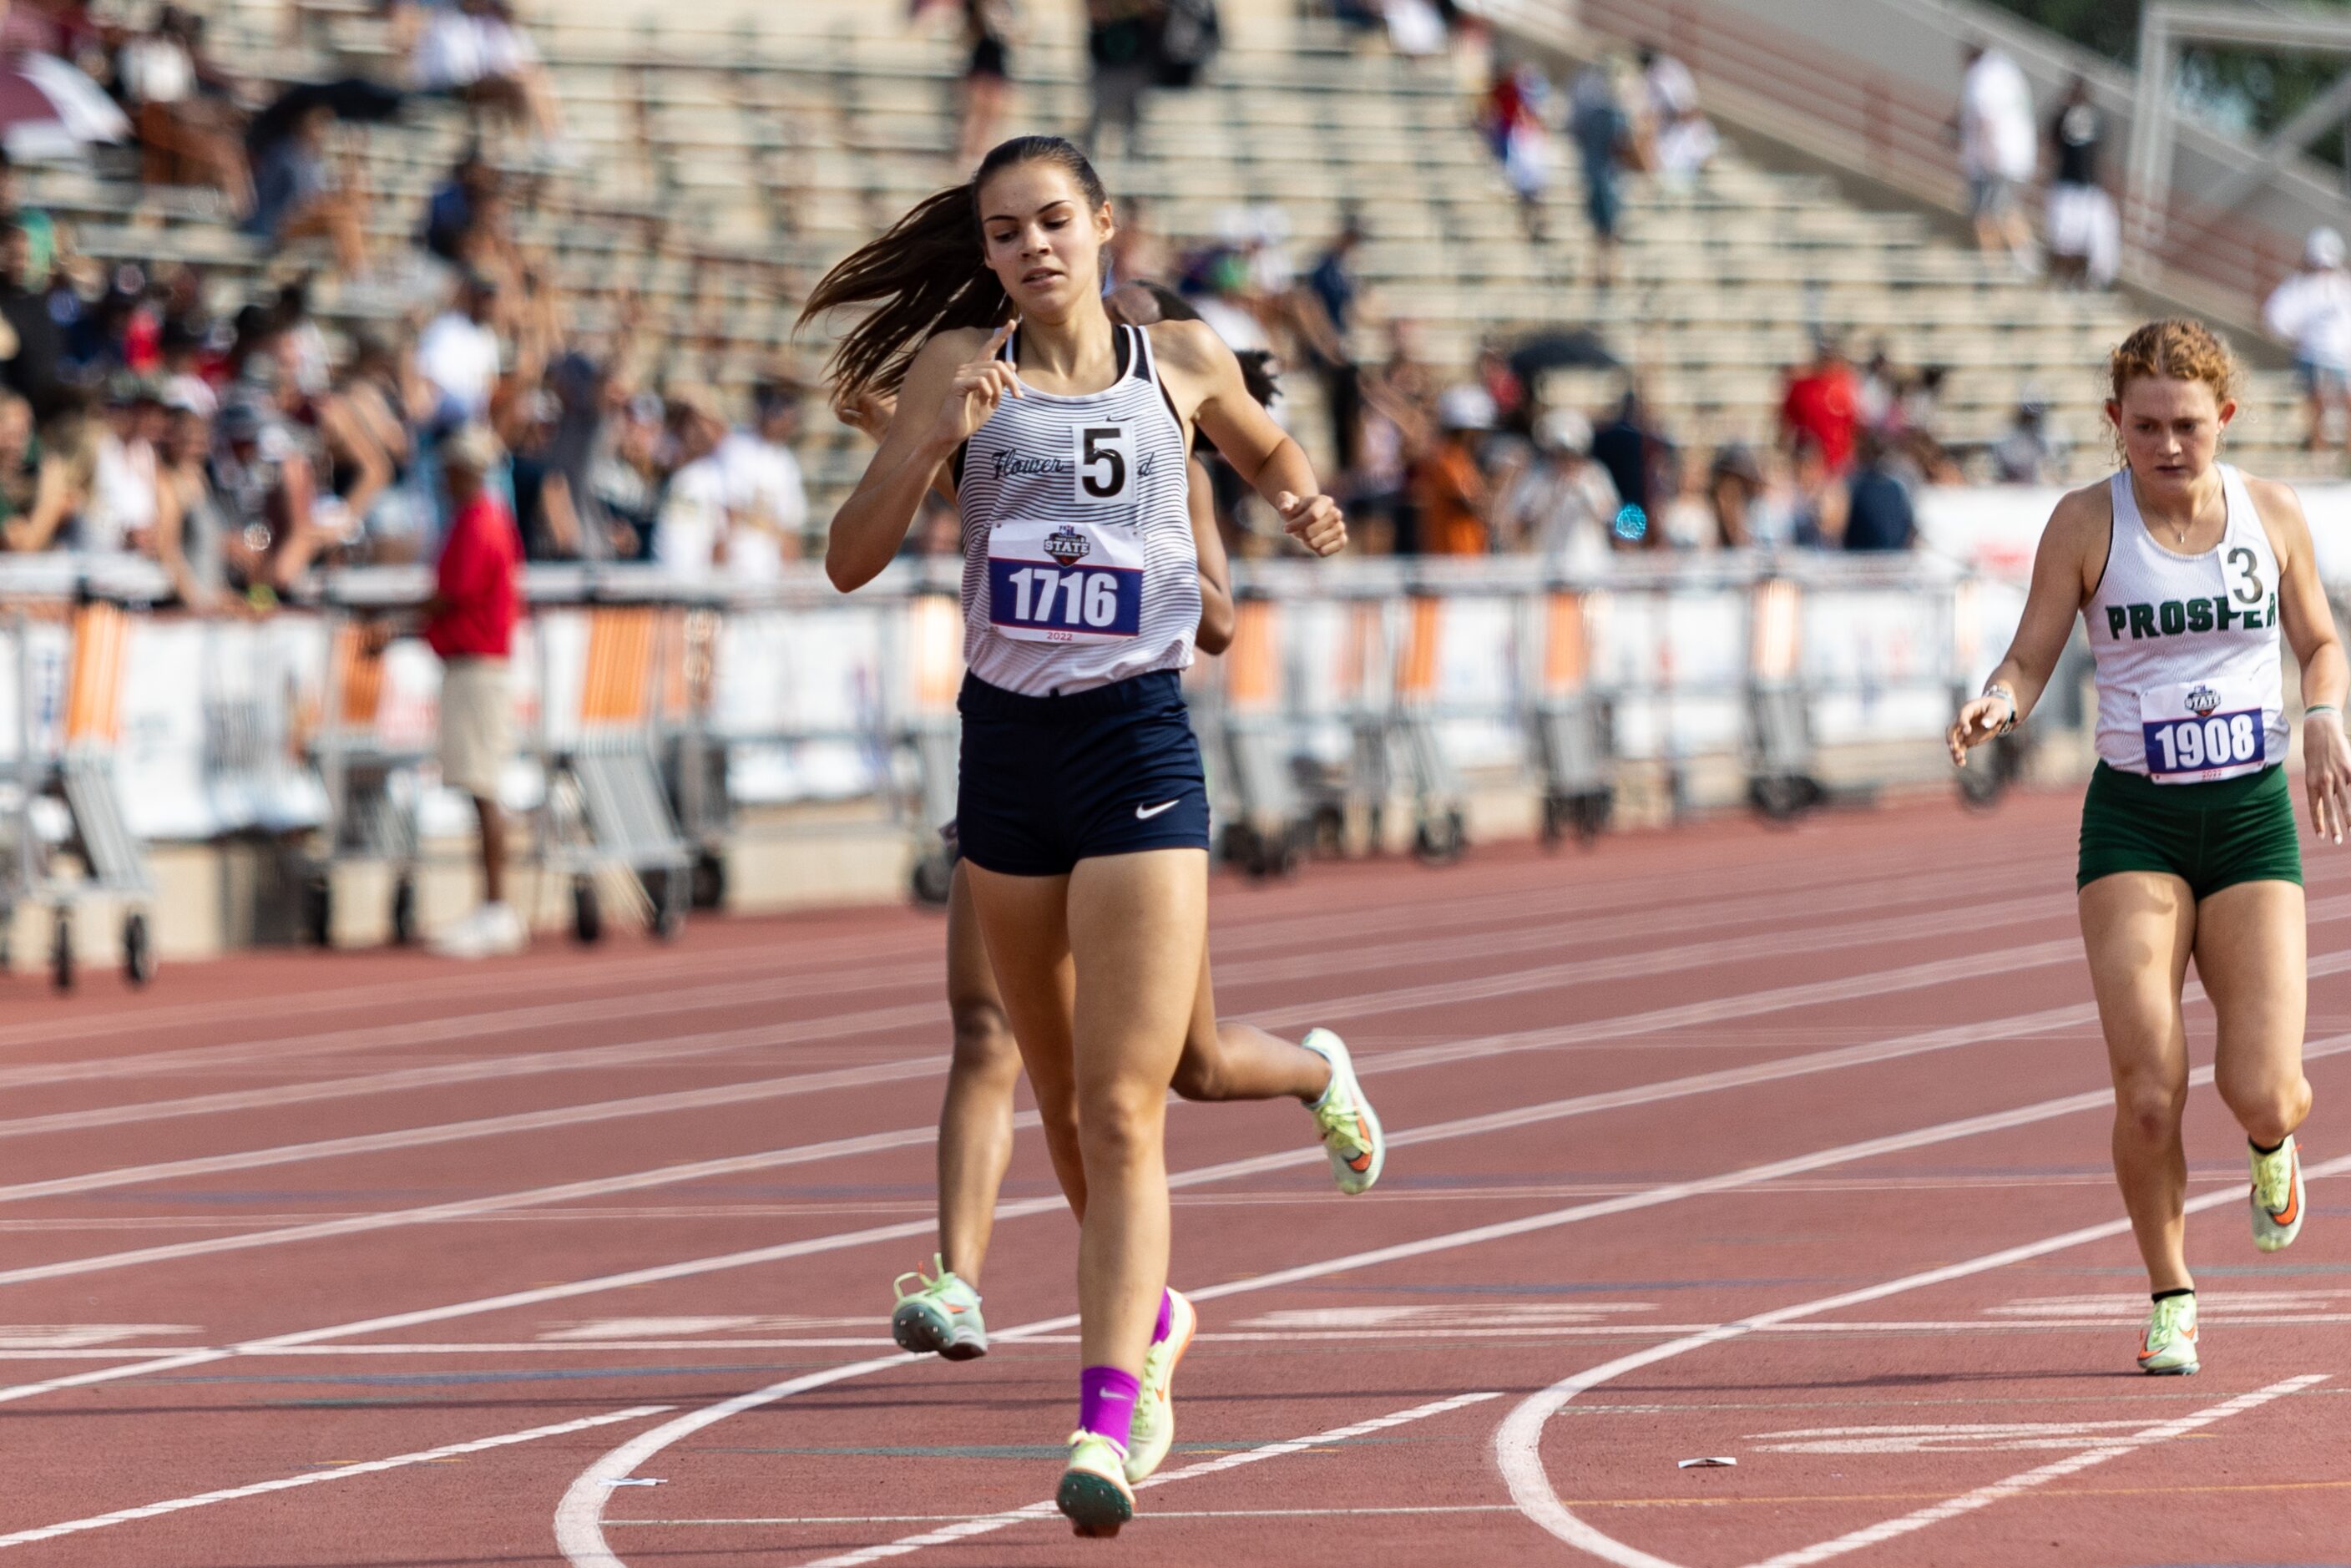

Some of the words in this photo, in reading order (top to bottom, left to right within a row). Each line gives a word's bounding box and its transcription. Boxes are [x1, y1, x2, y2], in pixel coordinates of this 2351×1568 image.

[991, 448, 1066, 480] Flower
[1082, 427, 1125, 498] 5
[1044, 540, 1090, 554] STATE
[2227, 547, 2263, 604] 3
[1009, 568, 1119, 628] 1716
[1047, 631, 1074, 642] 2022
[2155, 714, 2256, 771] 1908
